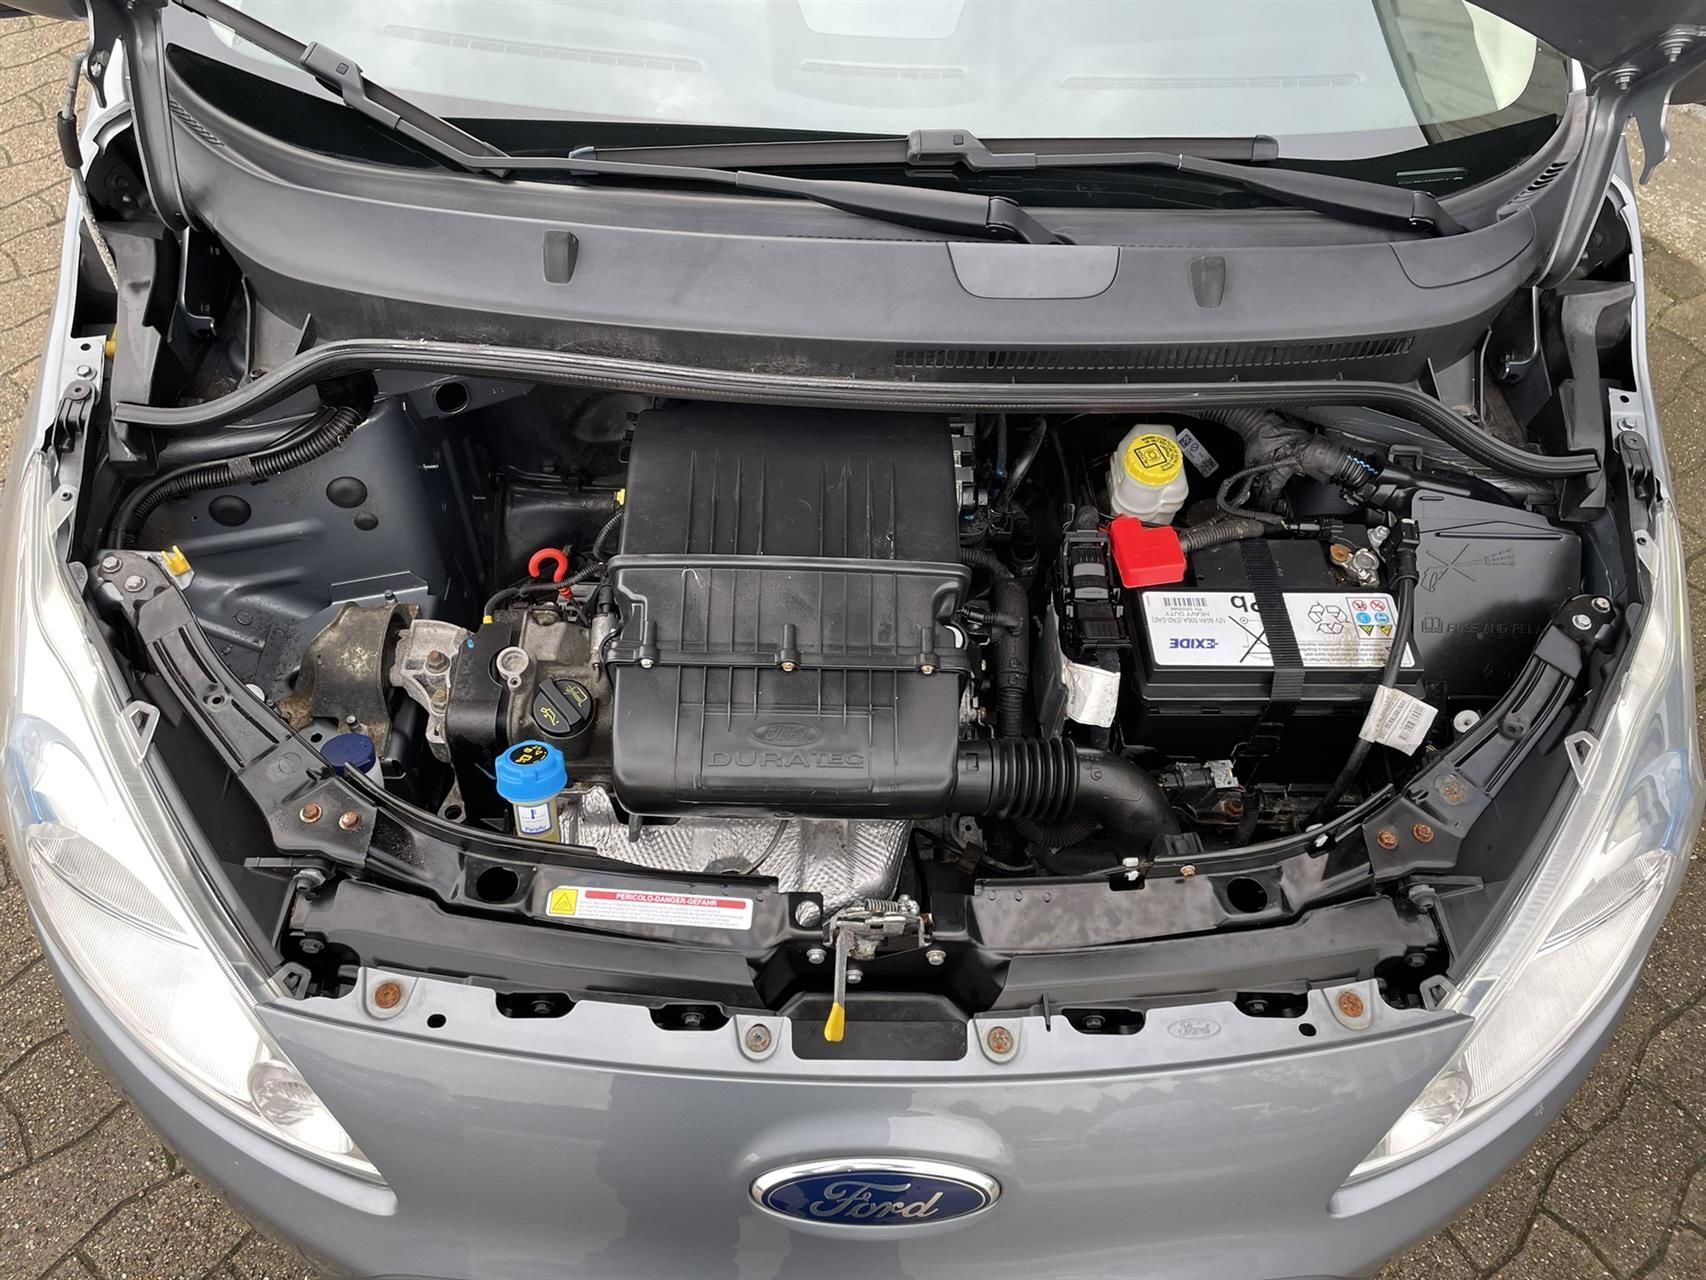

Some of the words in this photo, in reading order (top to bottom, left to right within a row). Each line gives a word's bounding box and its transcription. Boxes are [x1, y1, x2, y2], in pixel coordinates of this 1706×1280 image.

[1169, 638, 1218, 649] EXIDE
[706, 751, 864, 769] DURATEC
[809, 1180, 944, 1219] Ford
